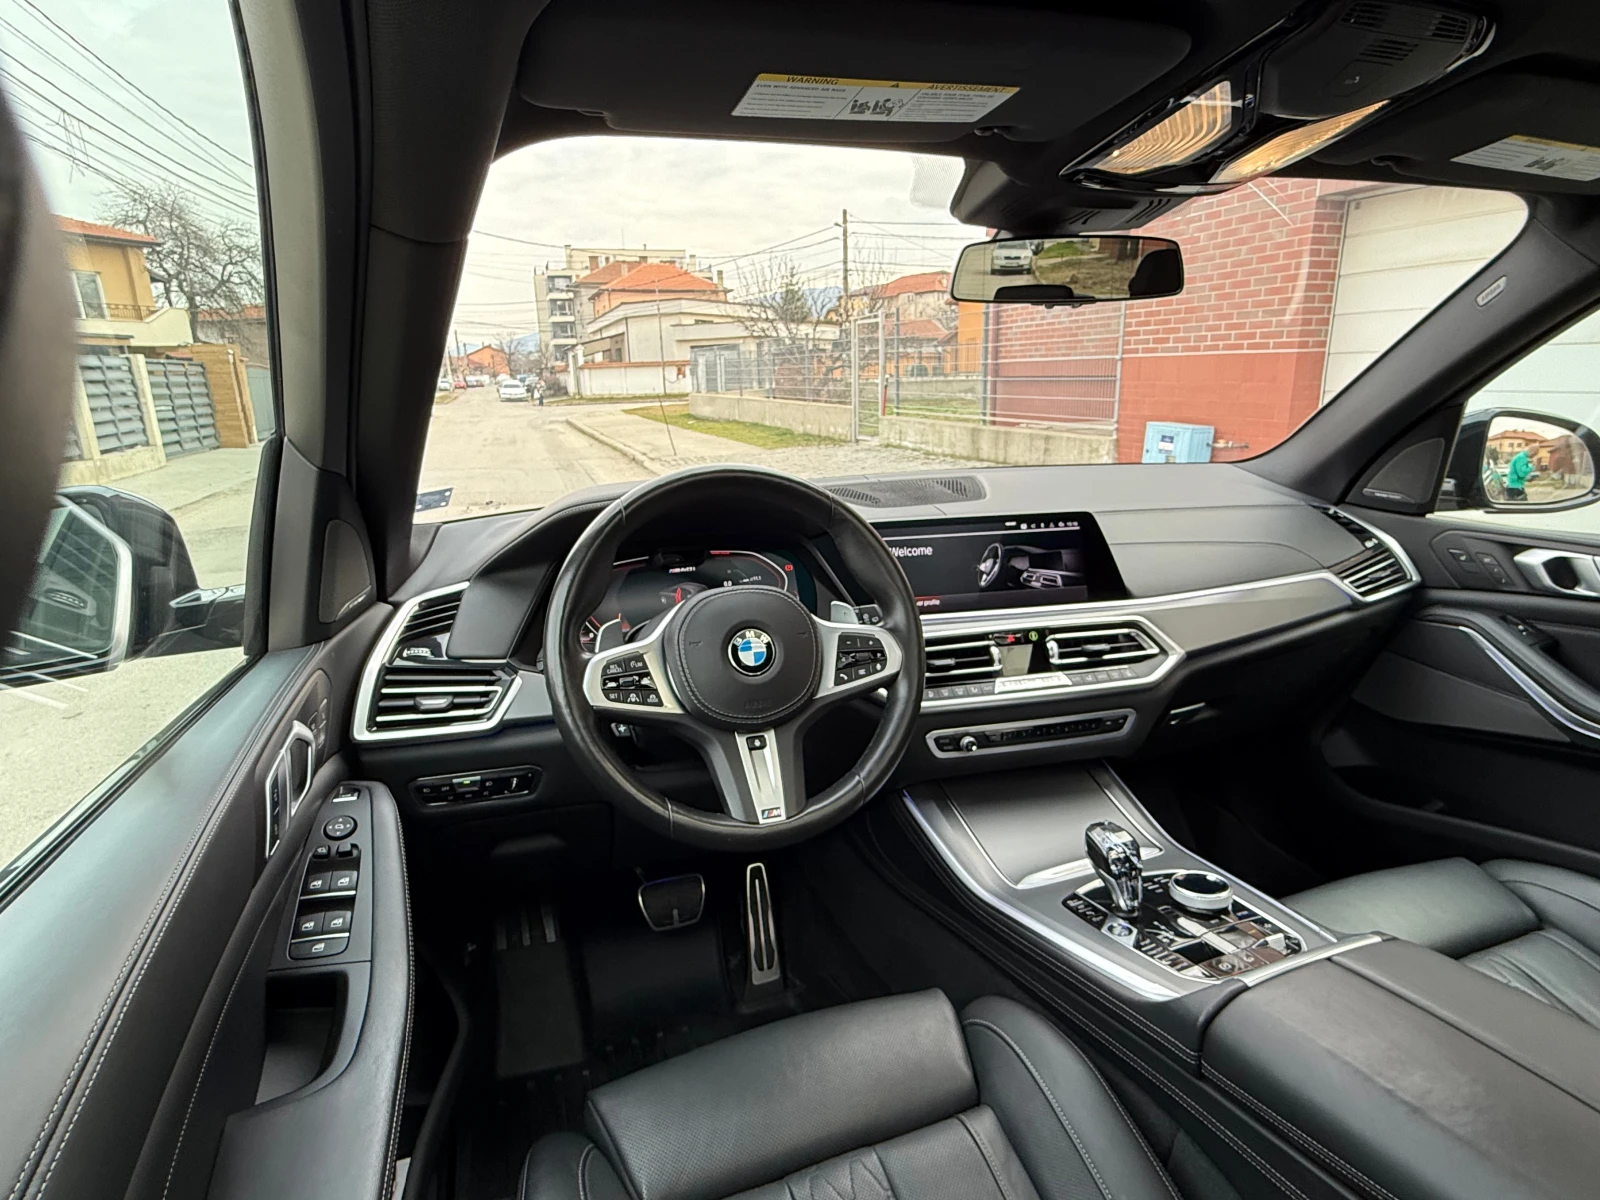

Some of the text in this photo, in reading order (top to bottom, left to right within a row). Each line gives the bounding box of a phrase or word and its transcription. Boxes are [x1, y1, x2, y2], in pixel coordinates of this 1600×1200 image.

[786, 76, 840, 86] WARNING
[926, 83, 1007, 93] AVERTISSEMENT
[889, 546, 933, 557] Welcome
[732, 630, 771, 647] BMW
